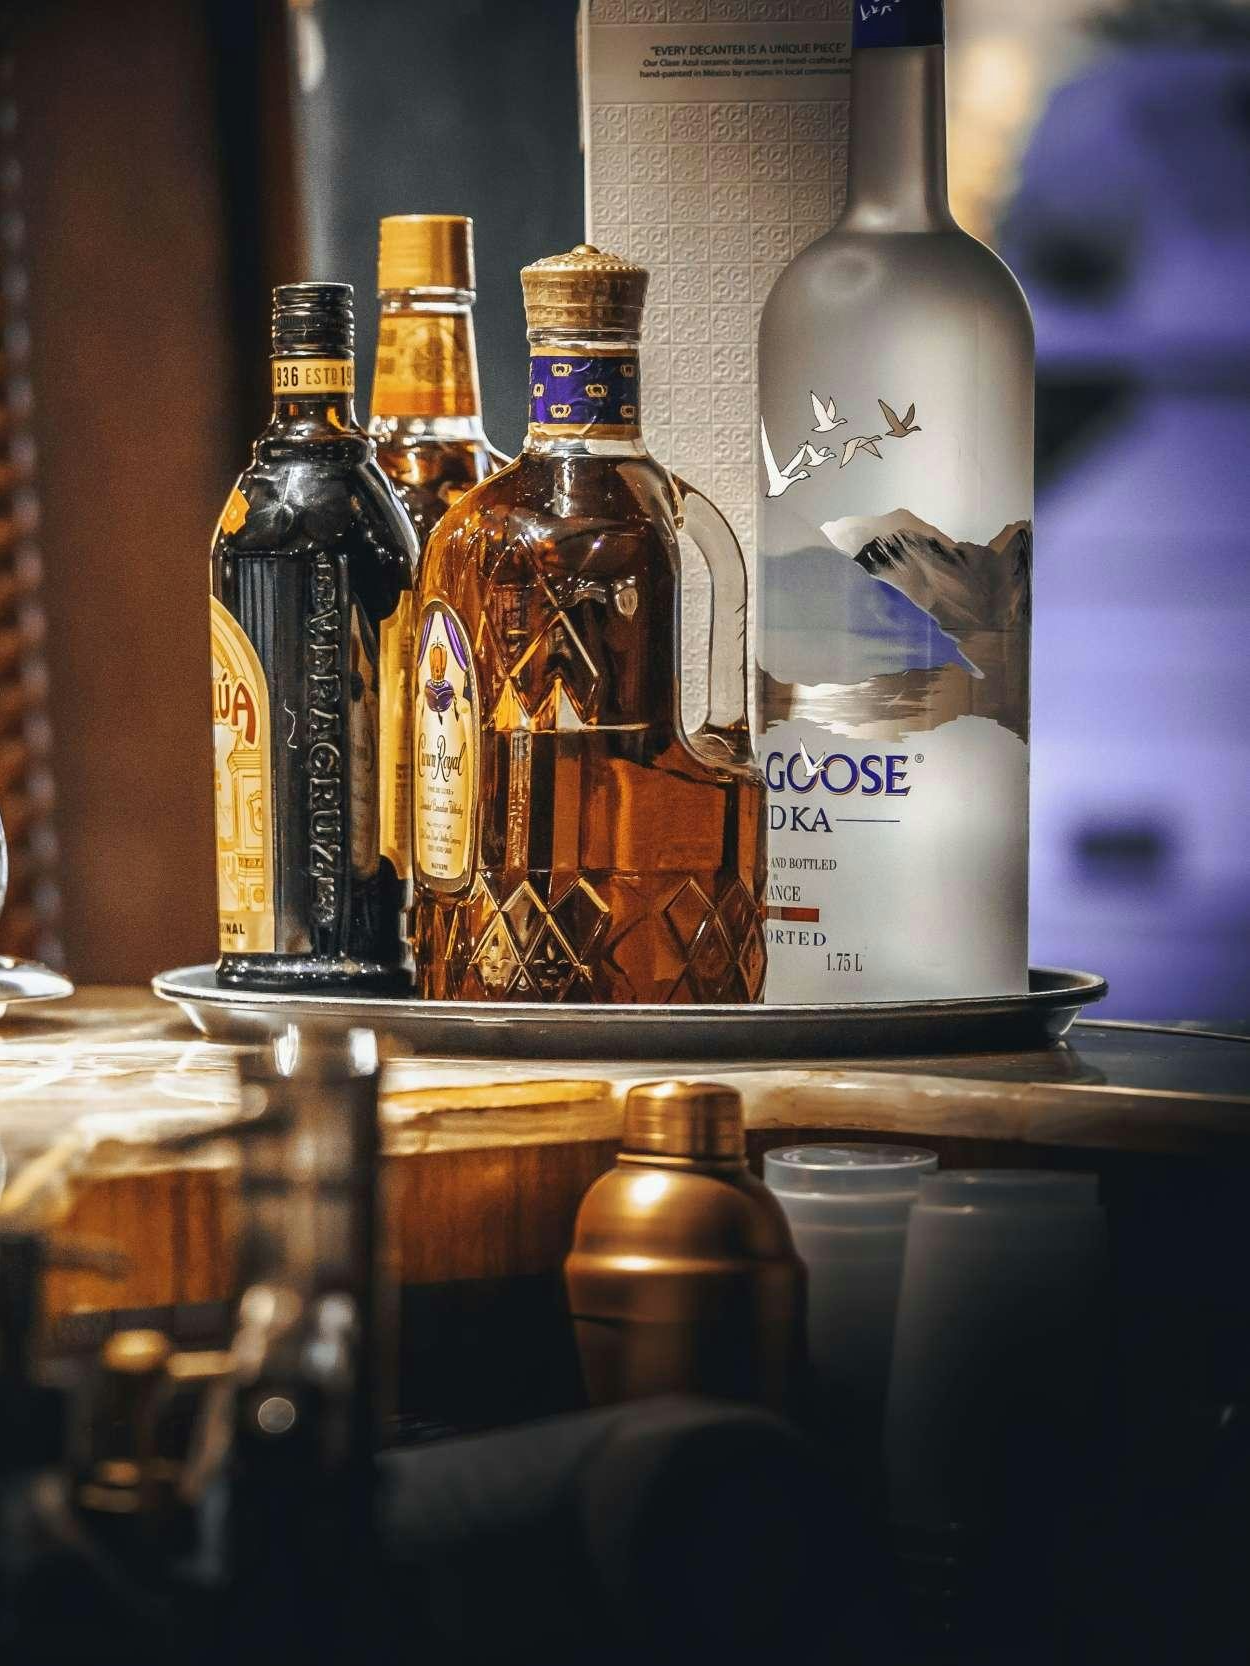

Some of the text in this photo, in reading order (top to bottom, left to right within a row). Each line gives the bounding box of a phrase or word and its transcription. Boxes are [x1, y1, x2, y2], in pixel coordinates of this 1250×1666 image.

[689, 45, 745, 56] DECANTER
[747, 45, 756, 55] IS
[757, 45, 767, 54] A
[769, 43, 811, 54] UNIQUE
[214, 672, 256, 745] ÚA
[431, 734, 467, 783] Royal
[770, 805, 833, 833] DKA
[789, 858, 837, 870] BOTTLED
[826, 953, 863, 972] 1.75 L
